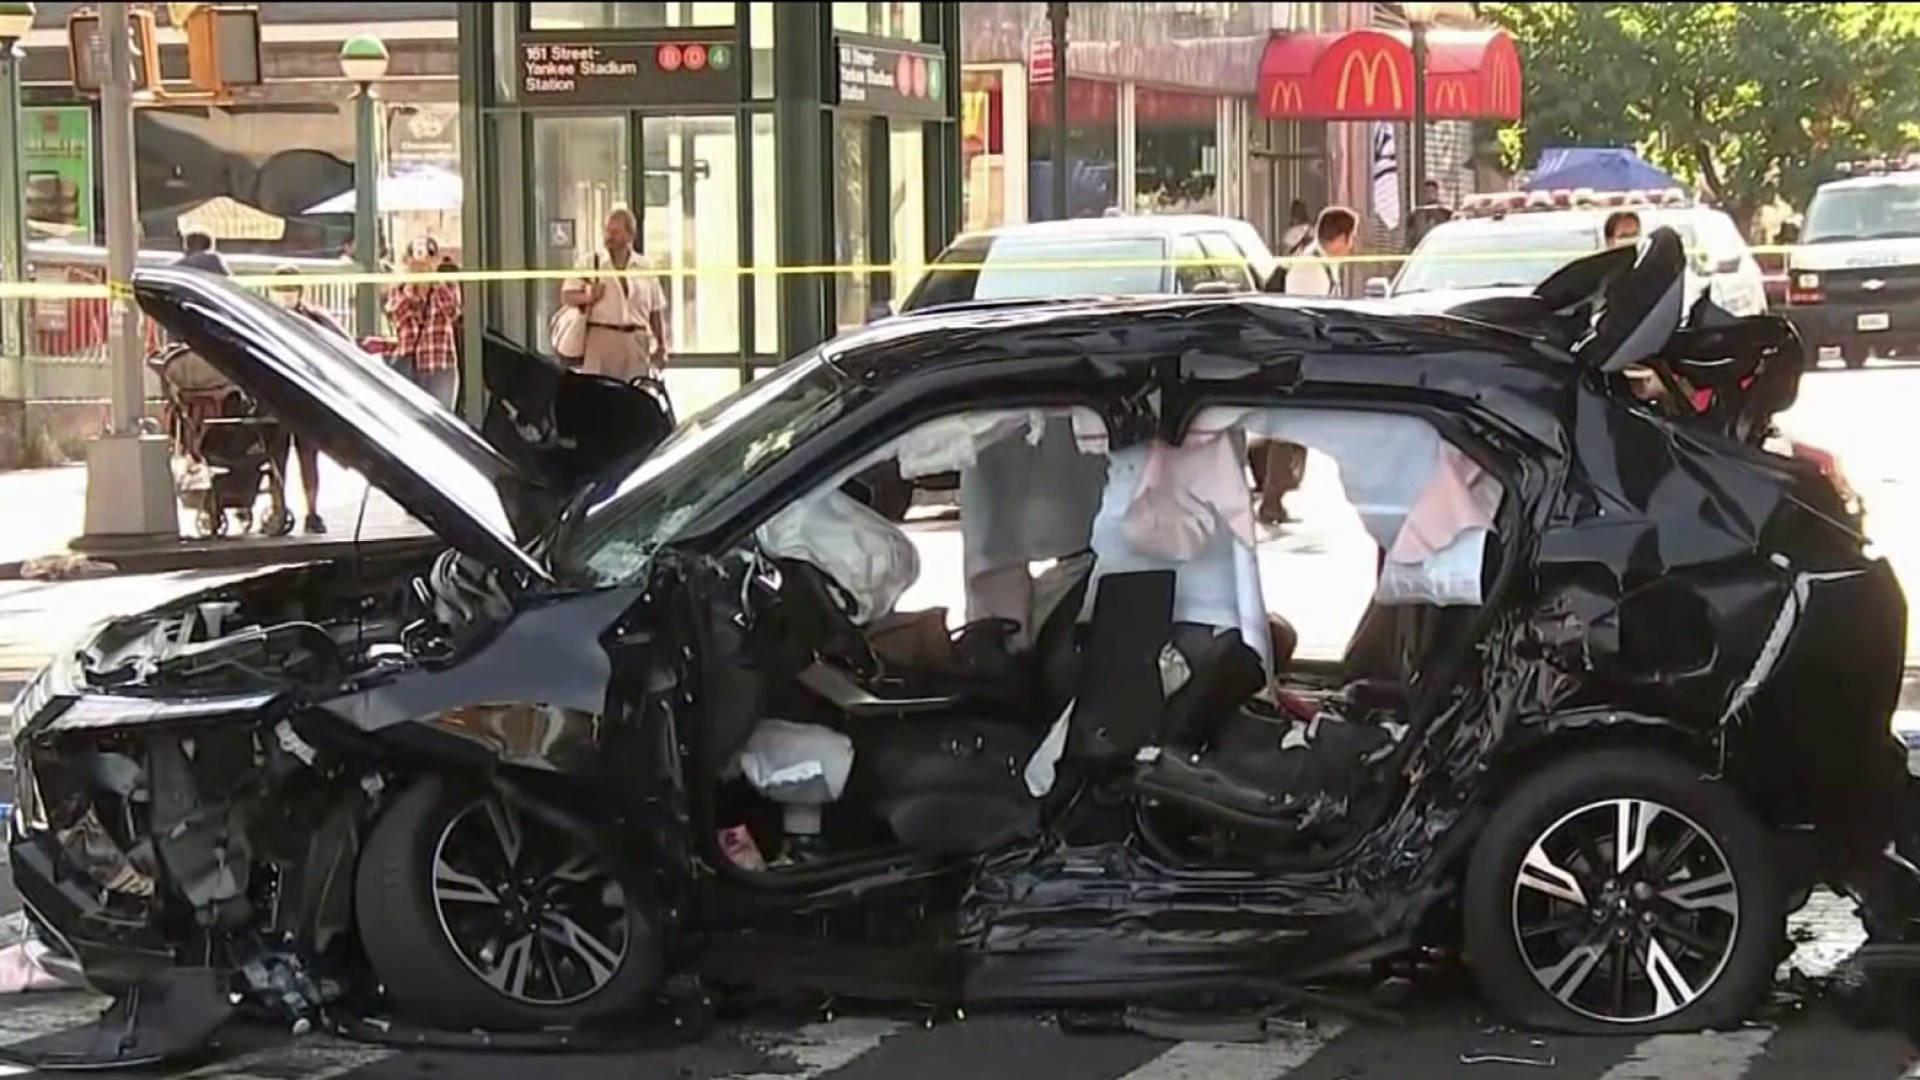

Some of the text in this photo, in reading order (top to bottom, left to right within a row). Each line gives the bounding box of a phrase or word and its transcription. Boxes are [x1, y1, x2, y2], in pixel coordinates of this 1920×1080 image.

[526, 47, 601, 60] 161 Street-
[526, 61, 637, 76] Yankee Stadium
[526, 78, 574, 92] Station
